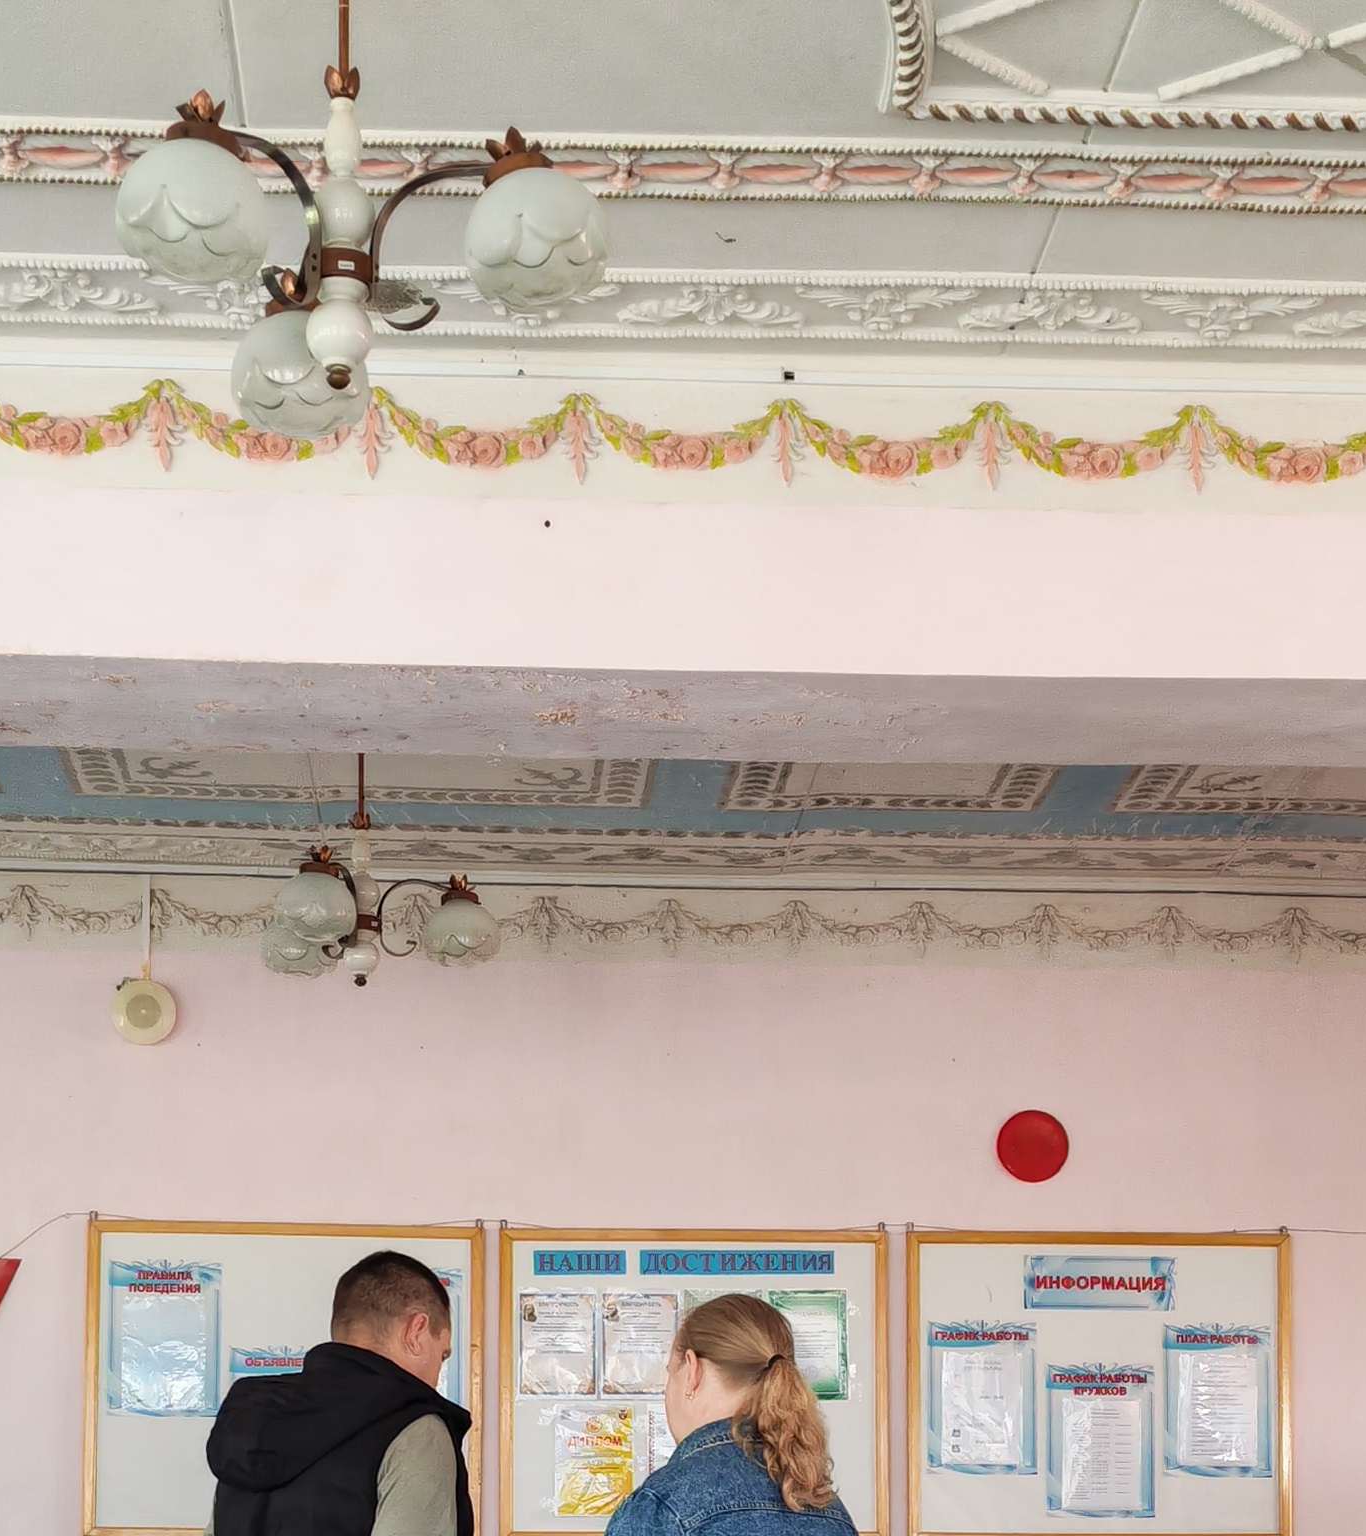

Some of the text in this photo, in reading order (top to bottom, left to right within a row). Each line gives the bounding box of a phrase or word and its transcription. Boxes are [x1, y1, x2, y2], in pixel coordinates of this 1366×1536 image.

[537, 1252, 833, 1275] НАШИ ДОСТИЖЕНИЯ
[137, 1270, 193, 1281] ПРАВИЛА
[129, 1283, 201, 1295] ПОВЕДЕНИЯ
[1036, 1276, 1166, 1293] ИНФОРМАЦИЯ
